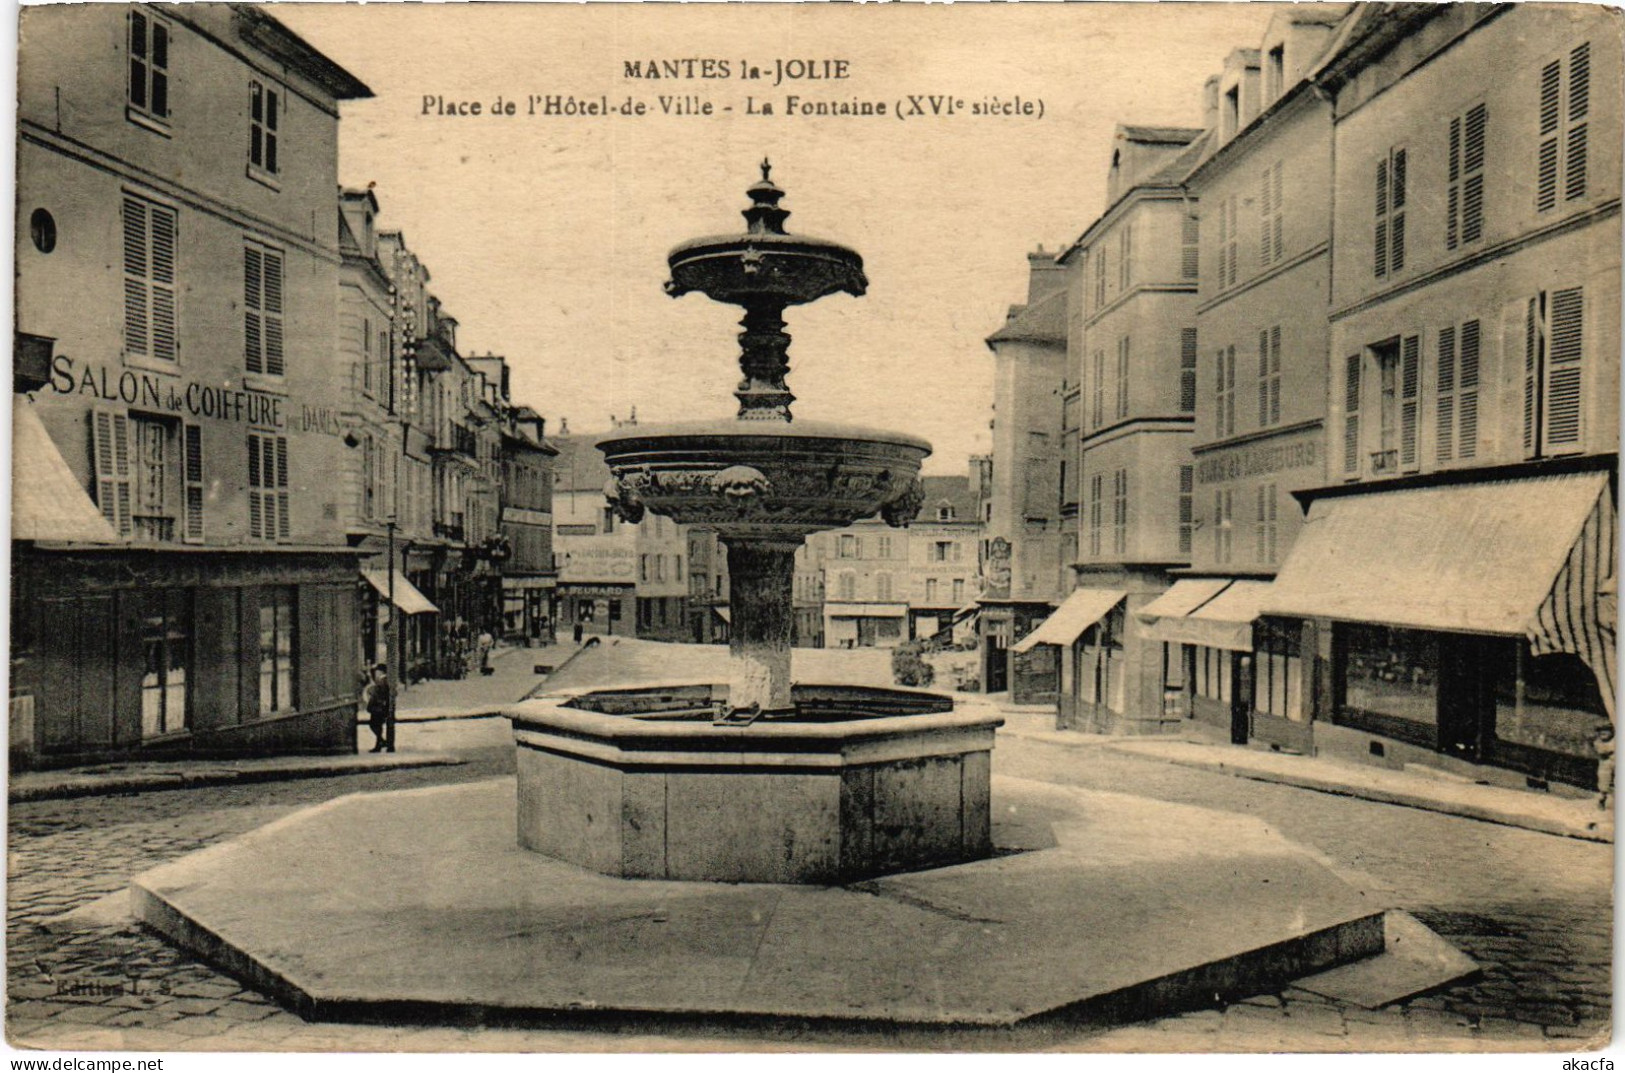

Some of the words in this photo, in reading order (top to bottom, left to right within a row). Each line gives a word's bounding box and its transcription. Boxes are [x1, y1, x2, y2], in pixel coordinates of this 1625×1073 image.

[52, 355, 162, 406] SALON
[166, 386, 183, 413] de
[186, 382, 284, 428] COIFFURE
